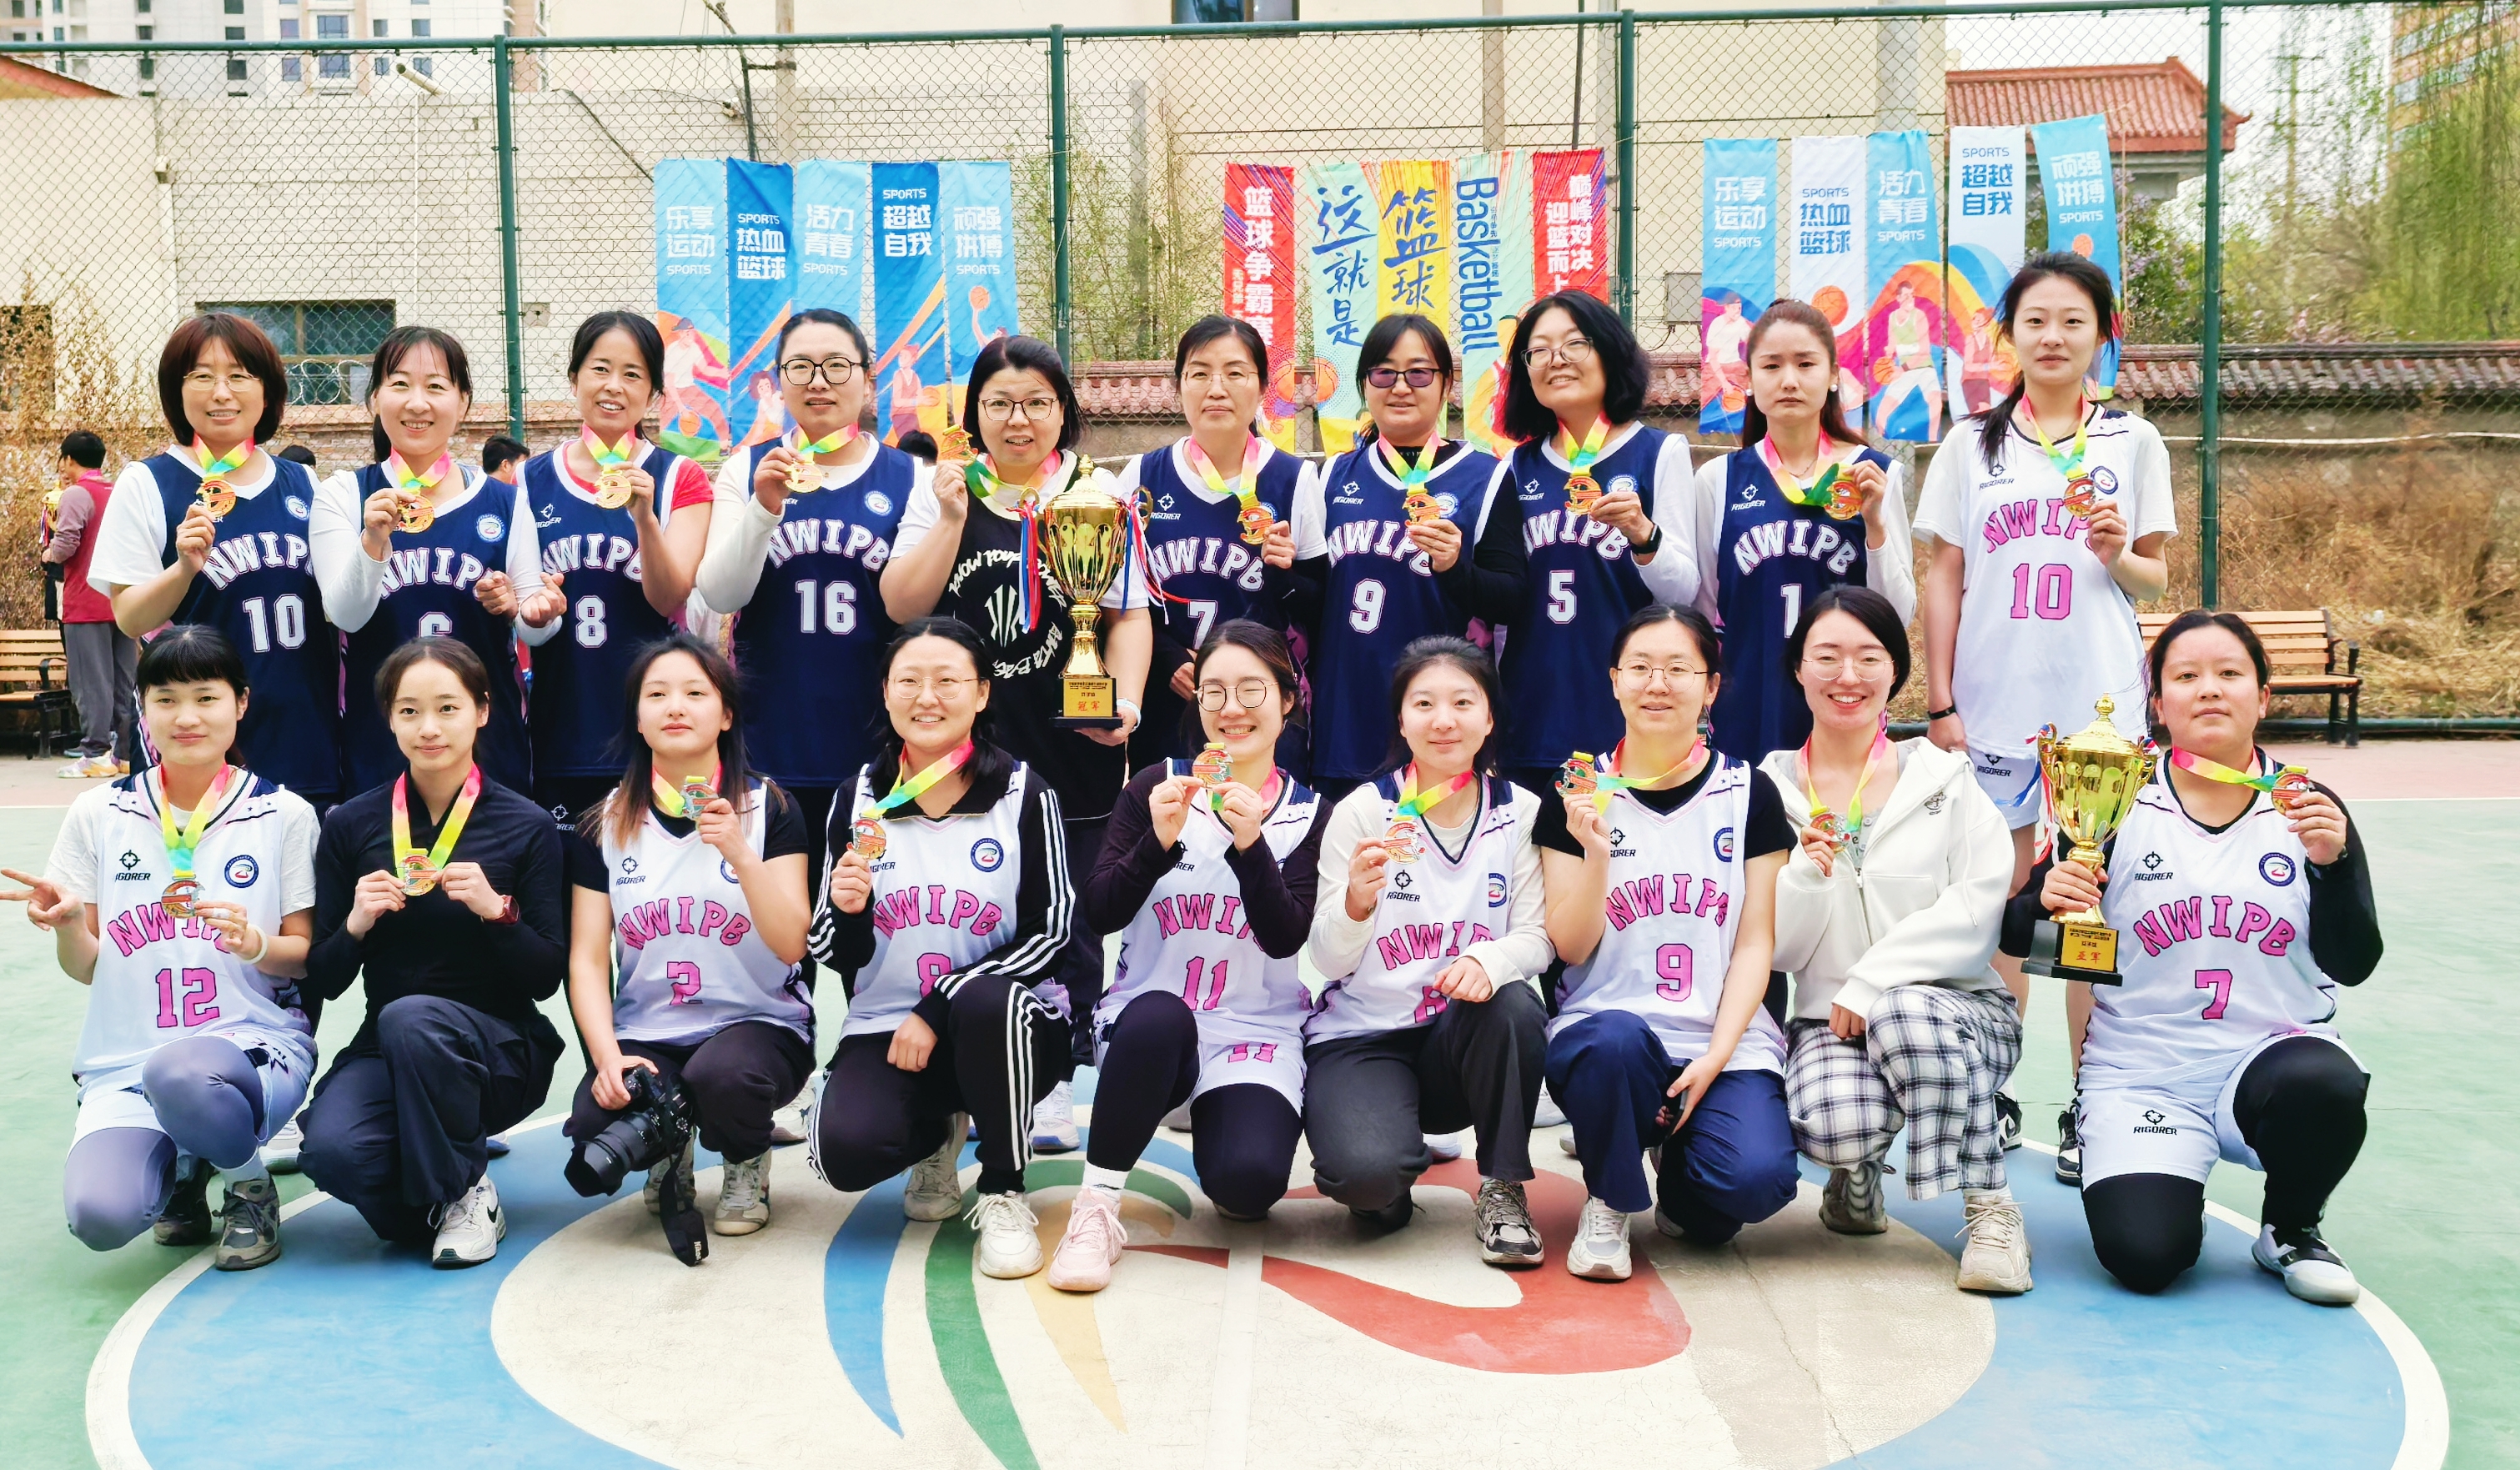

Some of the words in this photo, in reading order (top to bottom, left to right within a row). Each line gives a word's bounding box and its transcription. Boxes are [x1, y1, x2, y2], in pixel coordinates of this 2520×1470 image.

[1962, 147, 2010, 158] SPORTS
[2051, 151, 2101, 181] 顽强
[1879, 170, 1925, 196] 活力
[1961, 163, 2013, 188] 超越
[882, 188, 927, 201] SPORTS
[1714, 176, 1766, 203] 乐享
[1802, 187, 1850, 198] SPORTS
[2056, 178, 2106, 207] 拼搏
[806, 204, 855, 231] 活力
[883, 204, 932, 229] 超越
[1714, 204, 1766, 231] 运动
[1800, 202, 1851, 228] 热血
[1878, 198, 1928, 225] 青春
[1962, 191, 2013, 217] 自我
[2059, 211, 2104, 223] SPORTS
[666, 206, 715, 230] 乐享
[737, 213, 780, 225] SPORTS
[954, 206, 1001, 232] 顽强
[1569, 173, 1594, 271] 巅峰对决
[666, 233, 715, 258] 运动
[736, 228, 786, 253] 热血
[804, 233, 853, 258] 青春
[884, 233, 932, 258] 自我
[954, 234, 1002, 259] 拼搏
[1382, 186, 1447, 309] 篮球
[1545, 201, 1570, 296] 迎篮而上
[1714, 236, 1762, 248] SPORTS
[1799, 230, 1851, 255] 篮球
[1877, 230, 1925, 243] SPORTS
[666, 263, 711, 276] SPORTS
[736, 255, 786, 281] 篮球
[803, 262, 848, 276] SPORTS
[956, 263, 1001, 276] SPORTS
[1244, 185, 1274, 346] 篮球争霸赛
[1312, 184, 1378, 349] 这就是
[1456, 176, 1503, 355] Basketball
[1150, 512, 1181, 520] RGORER
[1730, 499, 1766, 511] RIGORER
[766, 518, 891, 572] NWIPB
[1733, 519, 1860, 576] NWIPB
[201, 531, 314, 590] NWIP
[379, 546, 494, 600] NWIP
[1547, 569, 1577, 625] 5
[2010, 562, 2072, 620] 10
[795, 579, 856, 635] 16
[1348, 577, 1387, 635] 9
[242, 593, 308, 654] 10
[575, 595, 607, 649] 8
[1187, 599, 1218, 650] 7
[1610, 849, 1636, 857] ORER
[115, 872, 151, 882] GORER
[615, 875, 646, 886] RGORER
[1386, 891, 1420, 902] RGORER
[1604, 873, 1730, 931] NWIPB
[618, 896, 751, 951] NWIPB
[873, 885, 1002, 940] NWIPB
[1152, 893, 1266, 952] NWI
[107, 902, 231, 957] NWI
[2133, 896, 2297, 958] NWIPB
[1182, 956, 1228, 1011] 11
[1656, 942, 1693, 1002] 9
[156, 967, 220, 1028] 12
[2194, 968, 2234, 1021] 7
[2132, 1126, 2177, 1136] RIGORER
